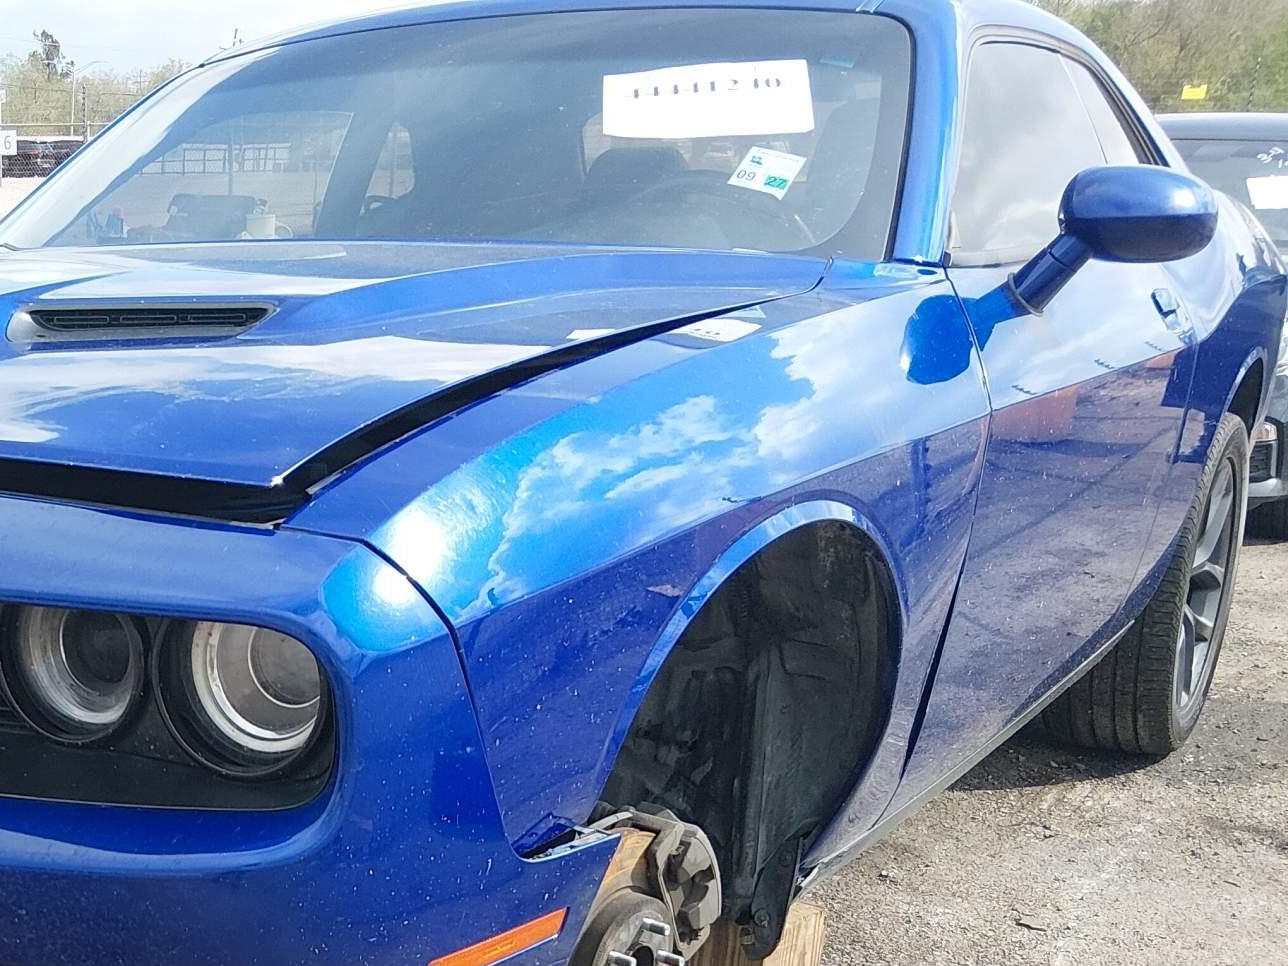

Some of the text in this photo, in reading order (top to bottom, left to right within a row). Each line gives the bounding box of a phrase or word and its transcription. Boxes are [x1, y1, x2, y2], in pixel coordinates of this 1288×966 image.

[3, 135, 12, 151] 6
[736, 169, 788, 191] 09 27
